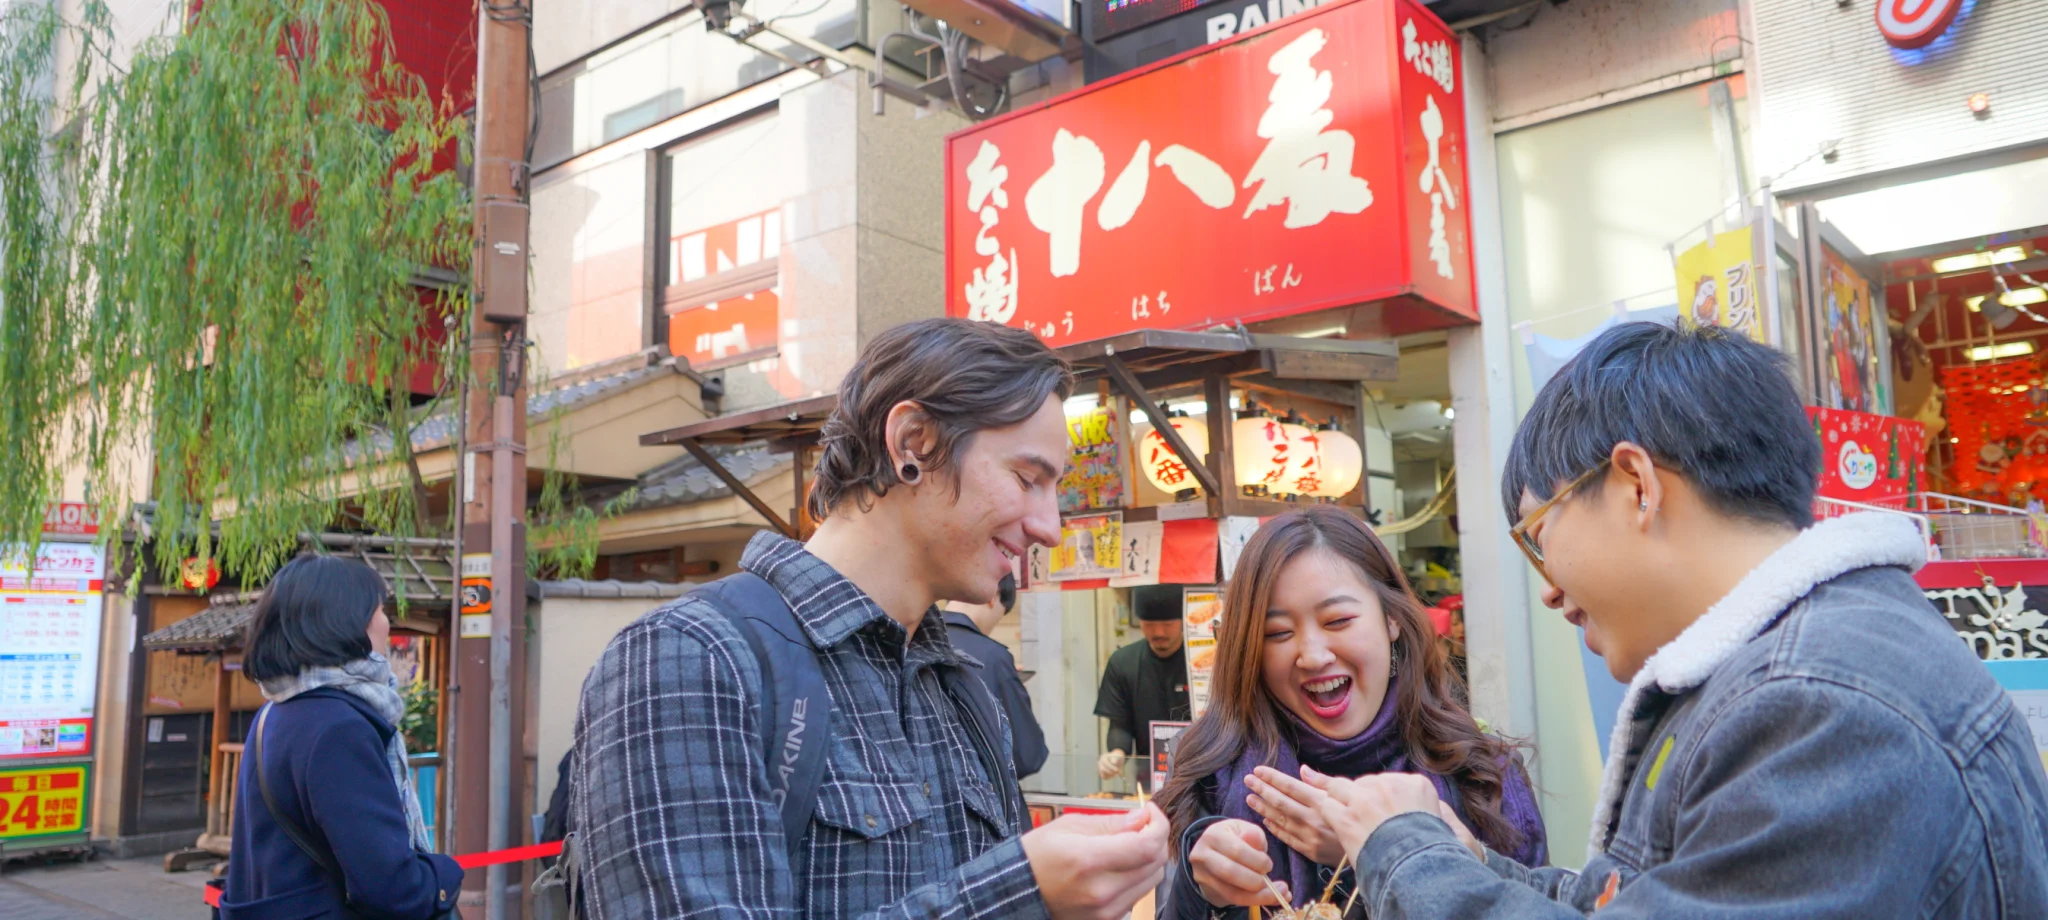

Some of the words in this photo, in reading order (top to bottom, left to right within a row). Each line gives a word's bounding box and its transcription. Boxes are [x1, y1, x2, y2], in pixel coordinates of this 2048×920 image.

[1206, 0, 1328, 45] RAIN
[1132, 290, 1171, 320] はち
[1254, 264, 1302, 295] ばん
[1725, 262, 1750, 334] プリン
[772, 696, 809, 814] DAKINE
